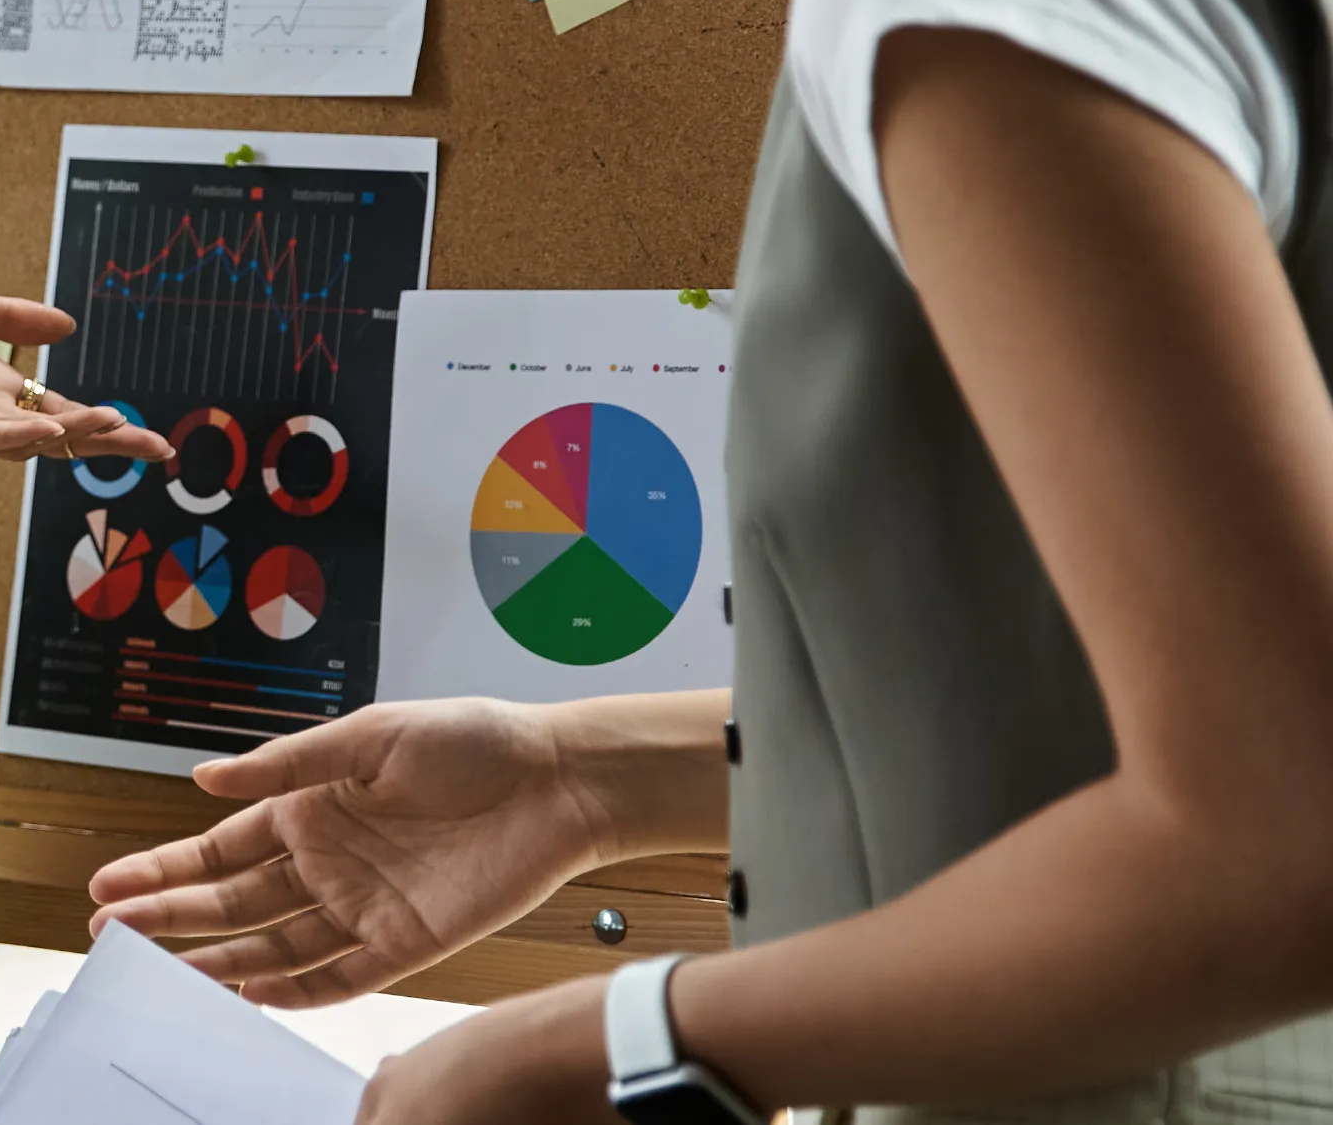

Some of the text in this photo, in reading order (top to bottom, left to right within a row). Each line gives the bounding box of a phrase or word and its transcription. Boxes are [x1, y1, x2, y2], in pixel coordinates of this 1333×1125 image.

[662, 364, 700, 374] September
[567, 443, 581, 452] 7%
[647, 491, 666, 500] 35%
[502, 556, 521, 566] 11%
[572, 618, 592, 627] 29%
